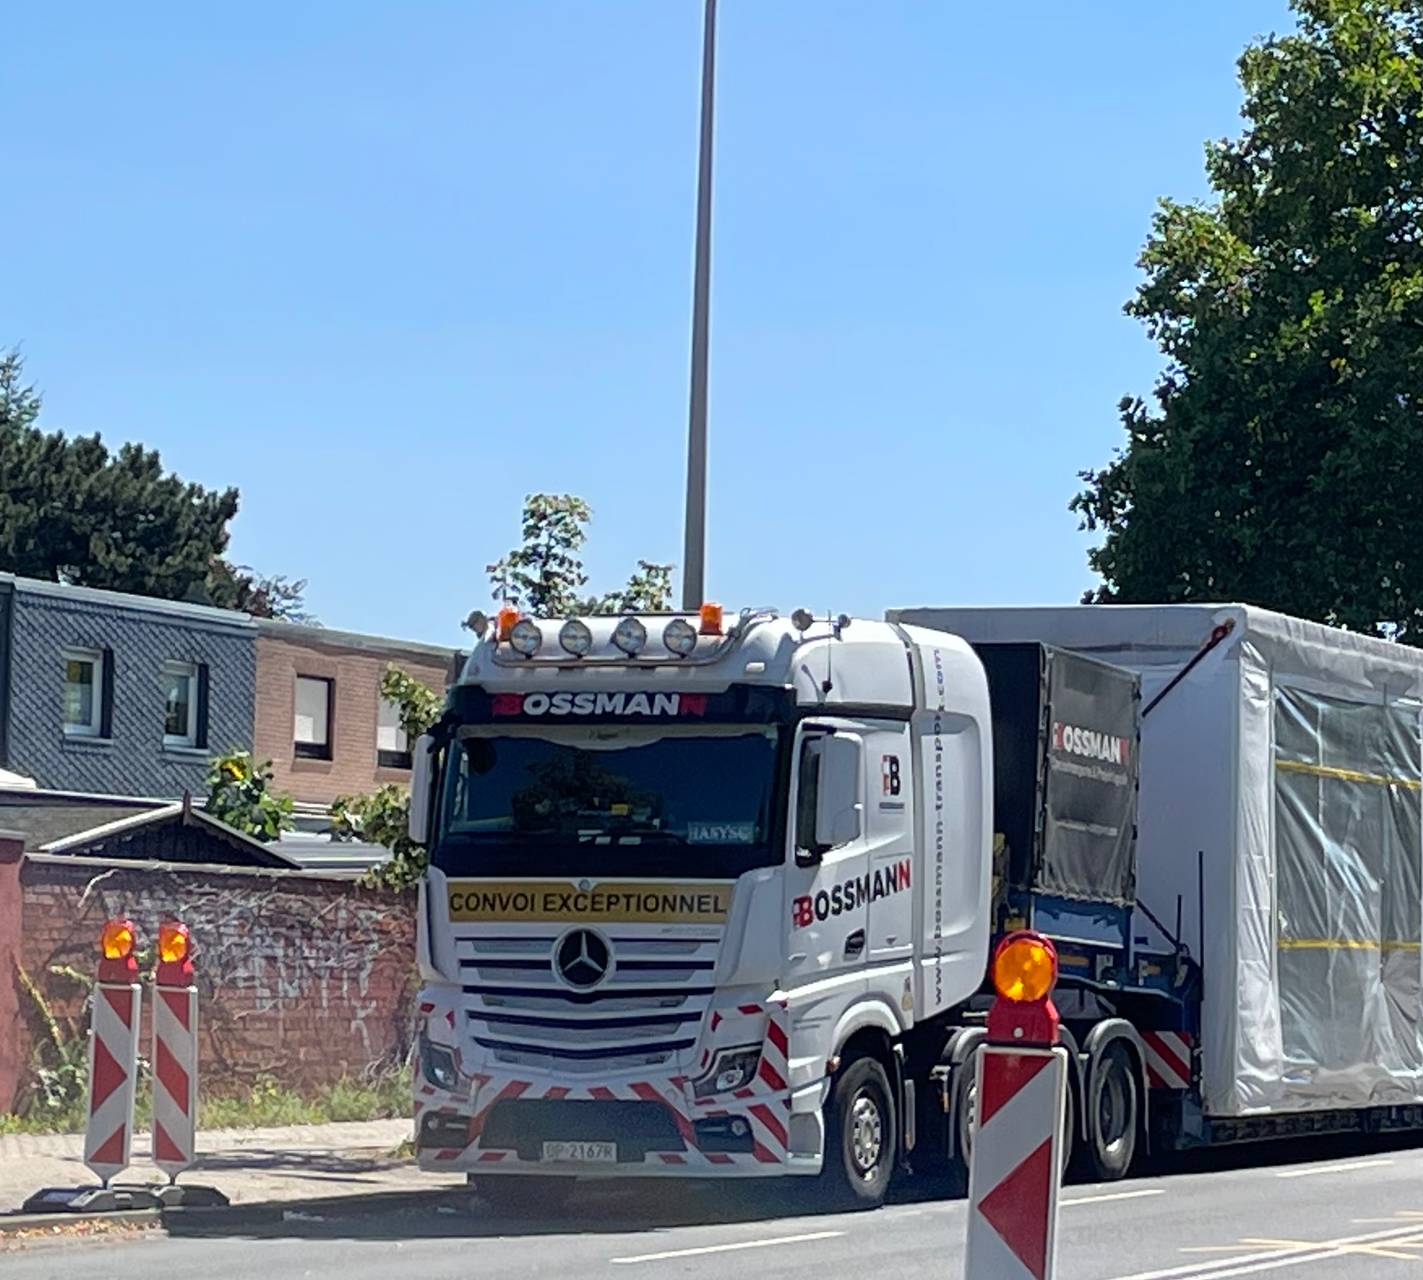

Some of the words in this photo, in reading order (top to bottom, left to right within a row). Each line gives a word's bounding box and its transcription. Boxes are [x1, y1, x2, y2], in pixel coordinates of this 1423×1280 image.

[492, 692, 707, 716] BOSSMANN
[1052, 720, 1130, 767] BOSSMANN
[450, 892, 536, 913] CONVOI
[542, 893, 728, 914] EXCEPTIONNEL
